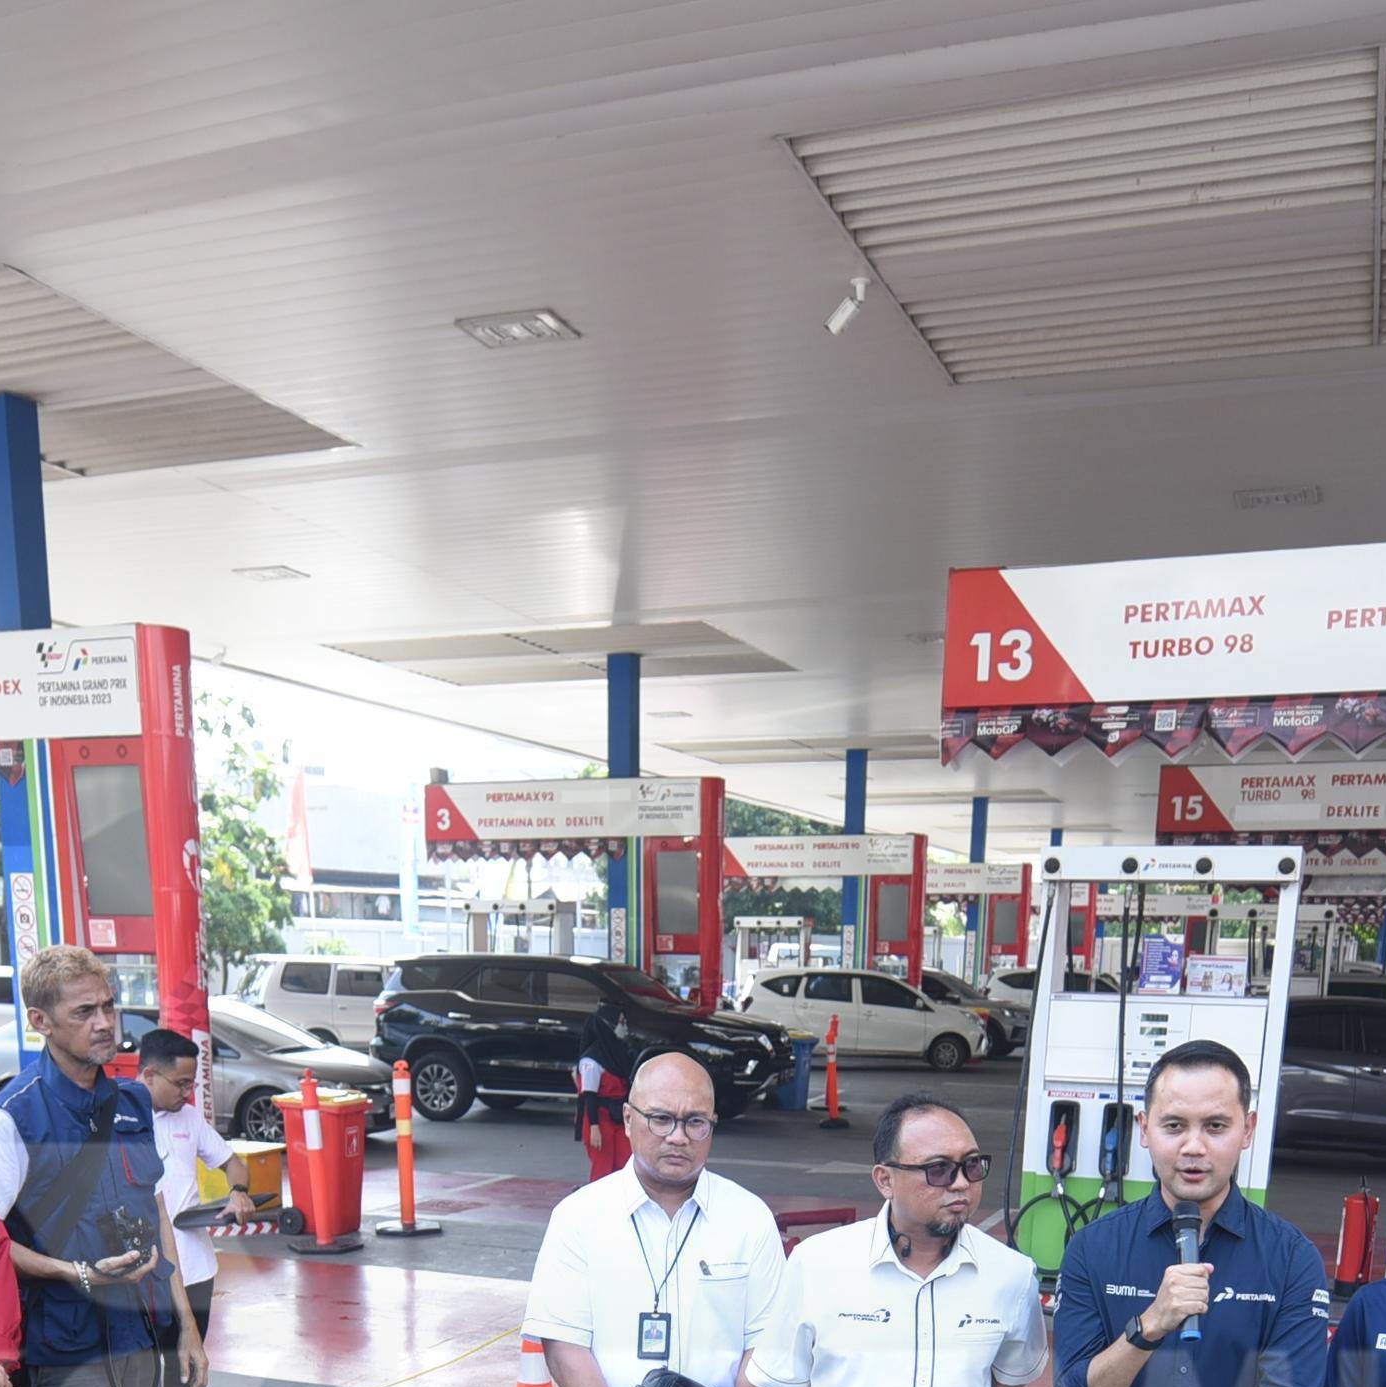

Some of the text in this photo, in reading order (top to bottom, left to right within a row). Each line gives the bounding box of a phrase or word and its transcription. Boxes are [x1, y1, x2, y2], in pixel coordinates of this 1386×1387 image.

[1123, 595, 1266, 624] PERTAMAX
[1128, 633, 1255, 660] TURBO 98
[970, 628, 1033, 682] 13
[37, 678, 127, 693] PERTAMINA GRAND PRIX
[50, 694, 90, 706] INDONESIA
[91, 692, 113, 705] 2023
[171, 664, 185, 737] PERTAMINA
[1272, 714, 1320, 728] MotoGP
[976, 724, 1019, 738] MotoGP
[1240, 775, 1316, 790] PERTAMAX
[485, 791, 555, 803] PERTAMAX 92
[1240, 789, 1282, 801] TURBO
[1170, 795, 1204, 822] 15
[1326, 805, 1381, 818] DEXLITE
[436, 807, 452, 832] 3
[478, 816, 556, 828] PERTAMINA DEX
[565, 815, 605, 827] DEXLITE
[1235, 1292, 1276, 1302] PERTAMINA
